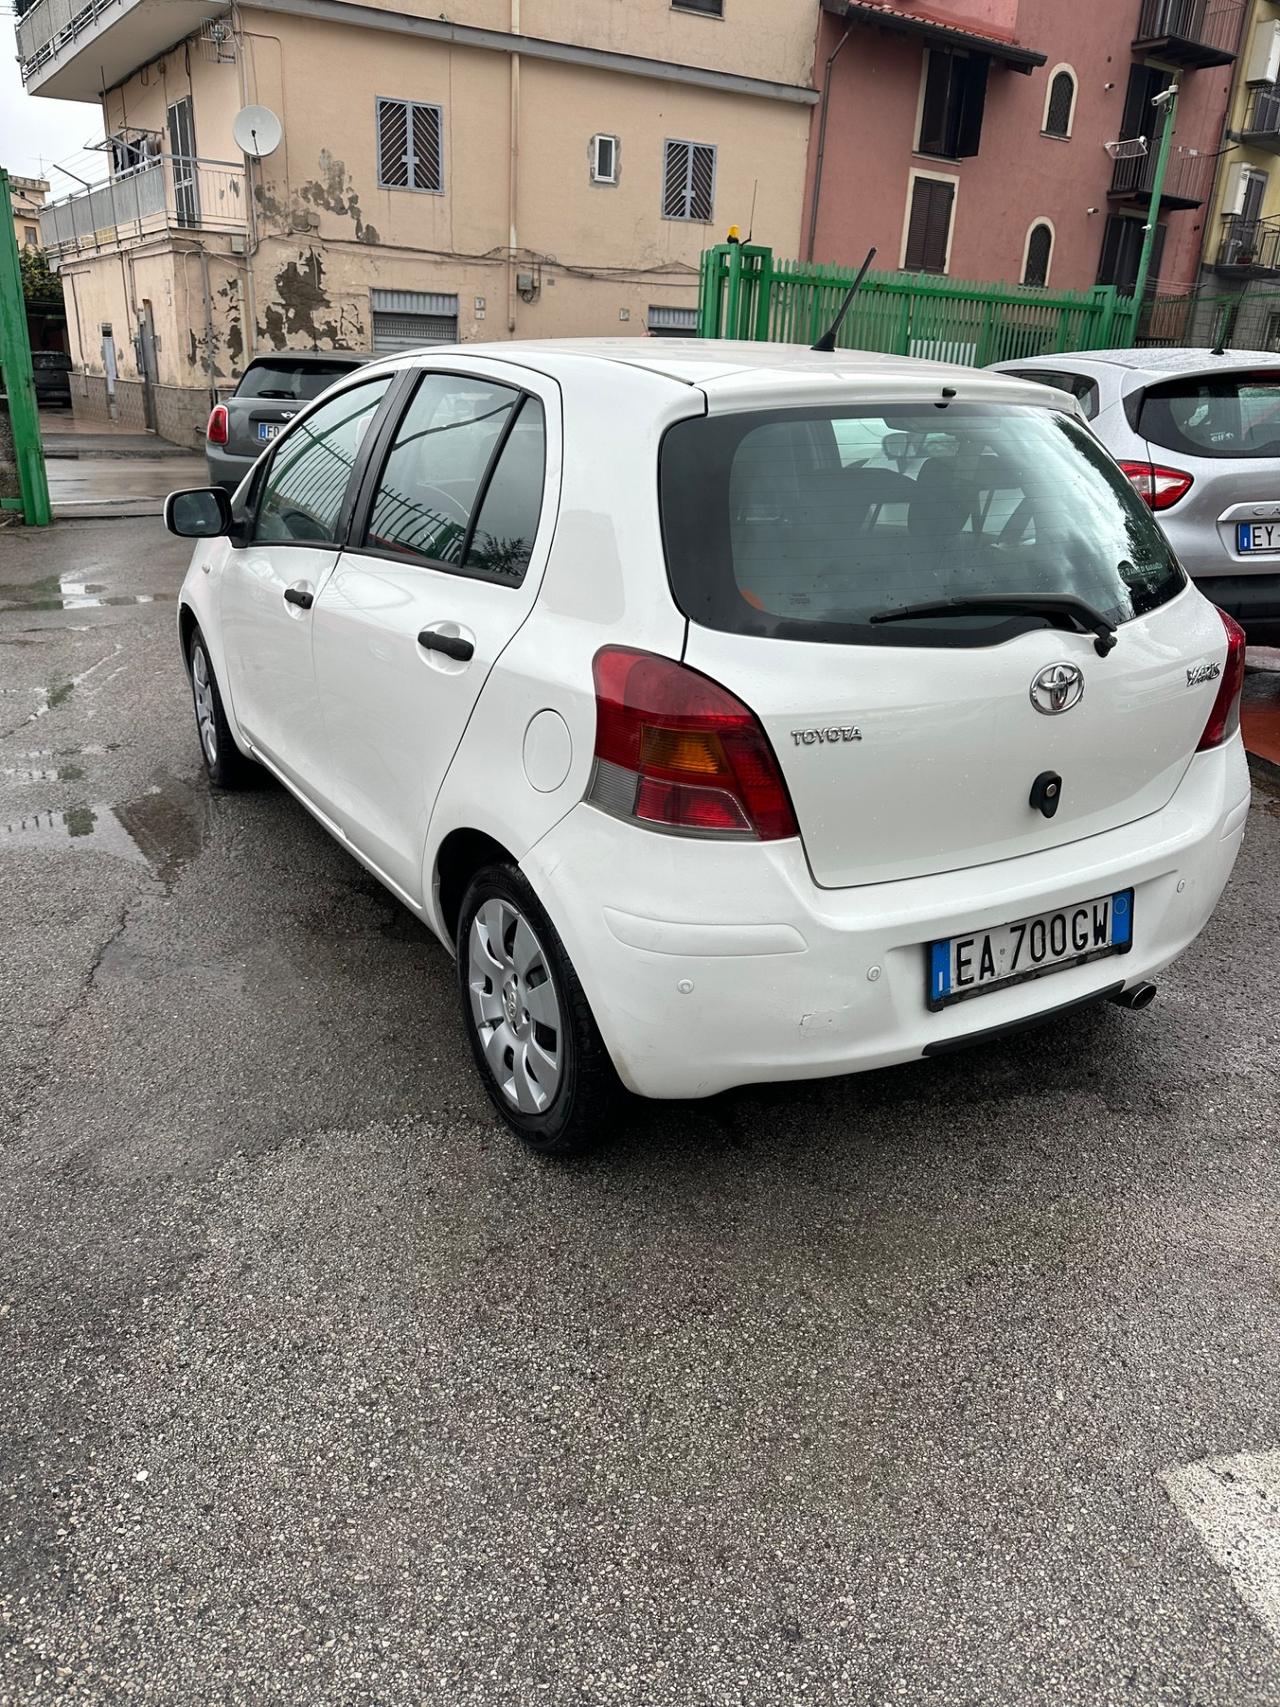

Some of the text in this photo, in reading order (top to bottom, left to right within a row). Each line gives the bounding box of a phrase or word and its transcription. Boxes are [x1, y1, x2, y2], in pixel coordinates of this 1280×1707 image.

[1252, 506, 1280, 516] CA
[1252, 525, 1275, 547] EY
[791, 725, 862, 746] TOYOTA
[938, 901, 1109, 992] I EA 700GW
